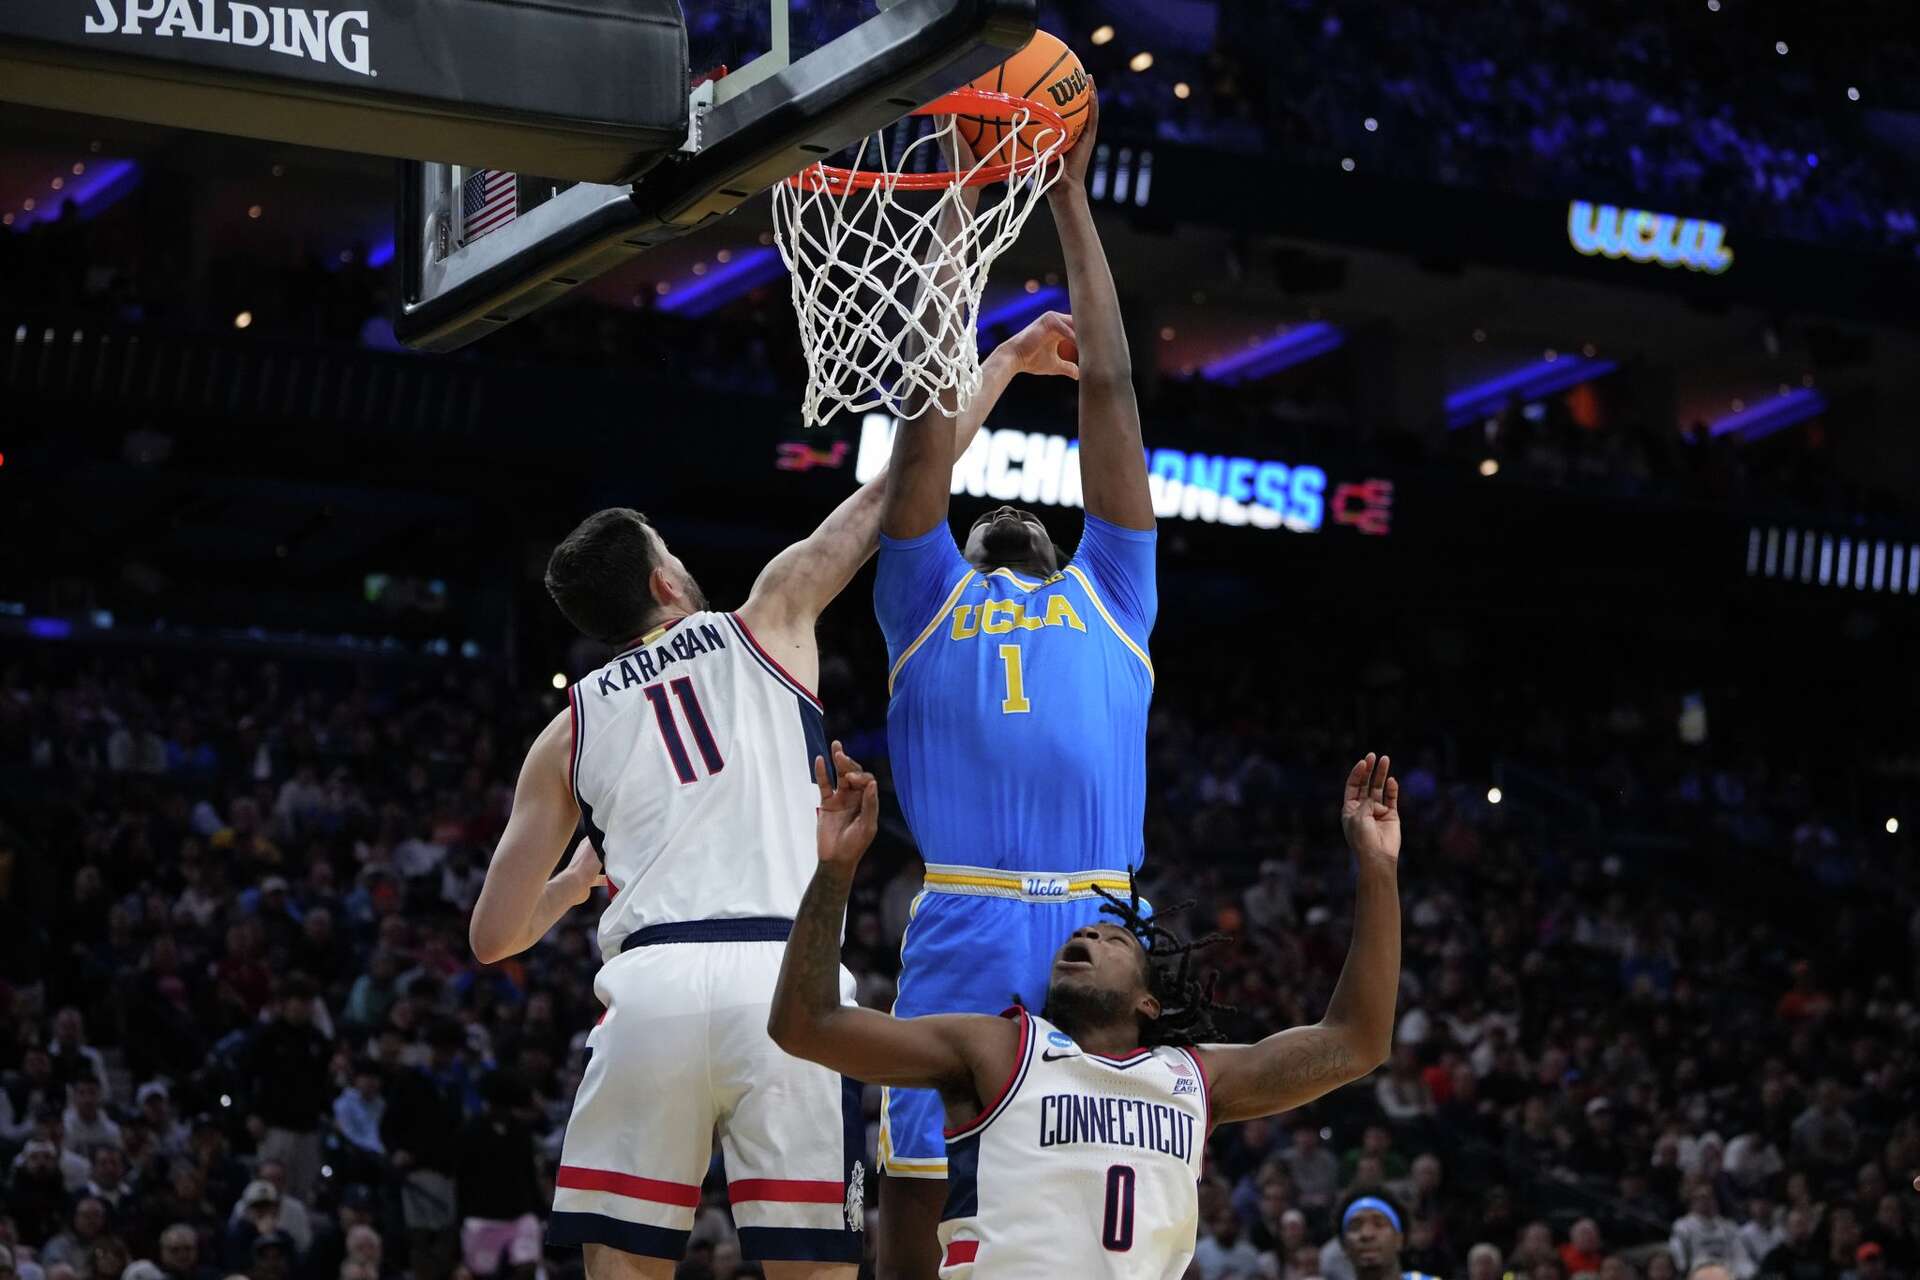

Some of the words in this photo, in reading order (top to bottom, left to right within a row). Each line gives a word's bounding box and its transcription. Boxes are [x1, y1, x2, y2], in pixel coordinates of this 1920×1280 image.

[85, 0, 370, 76] SPALDING
[855, 412, 1067, 506] MRCH
[1066, 436, 1327, 534] DNESS
[950, 594, 1088, 641] UCLA
[597, 623, 726, 697] KARABAN
[998, 643, 1031, 715] 1
[642, 675, 725, 785] 11
[1026, 878, 1064, 897] Ucla
[1040, 1093, 1195, 1165] CONNECTICUT
[1102, 1164, 1136, 1253] 0
